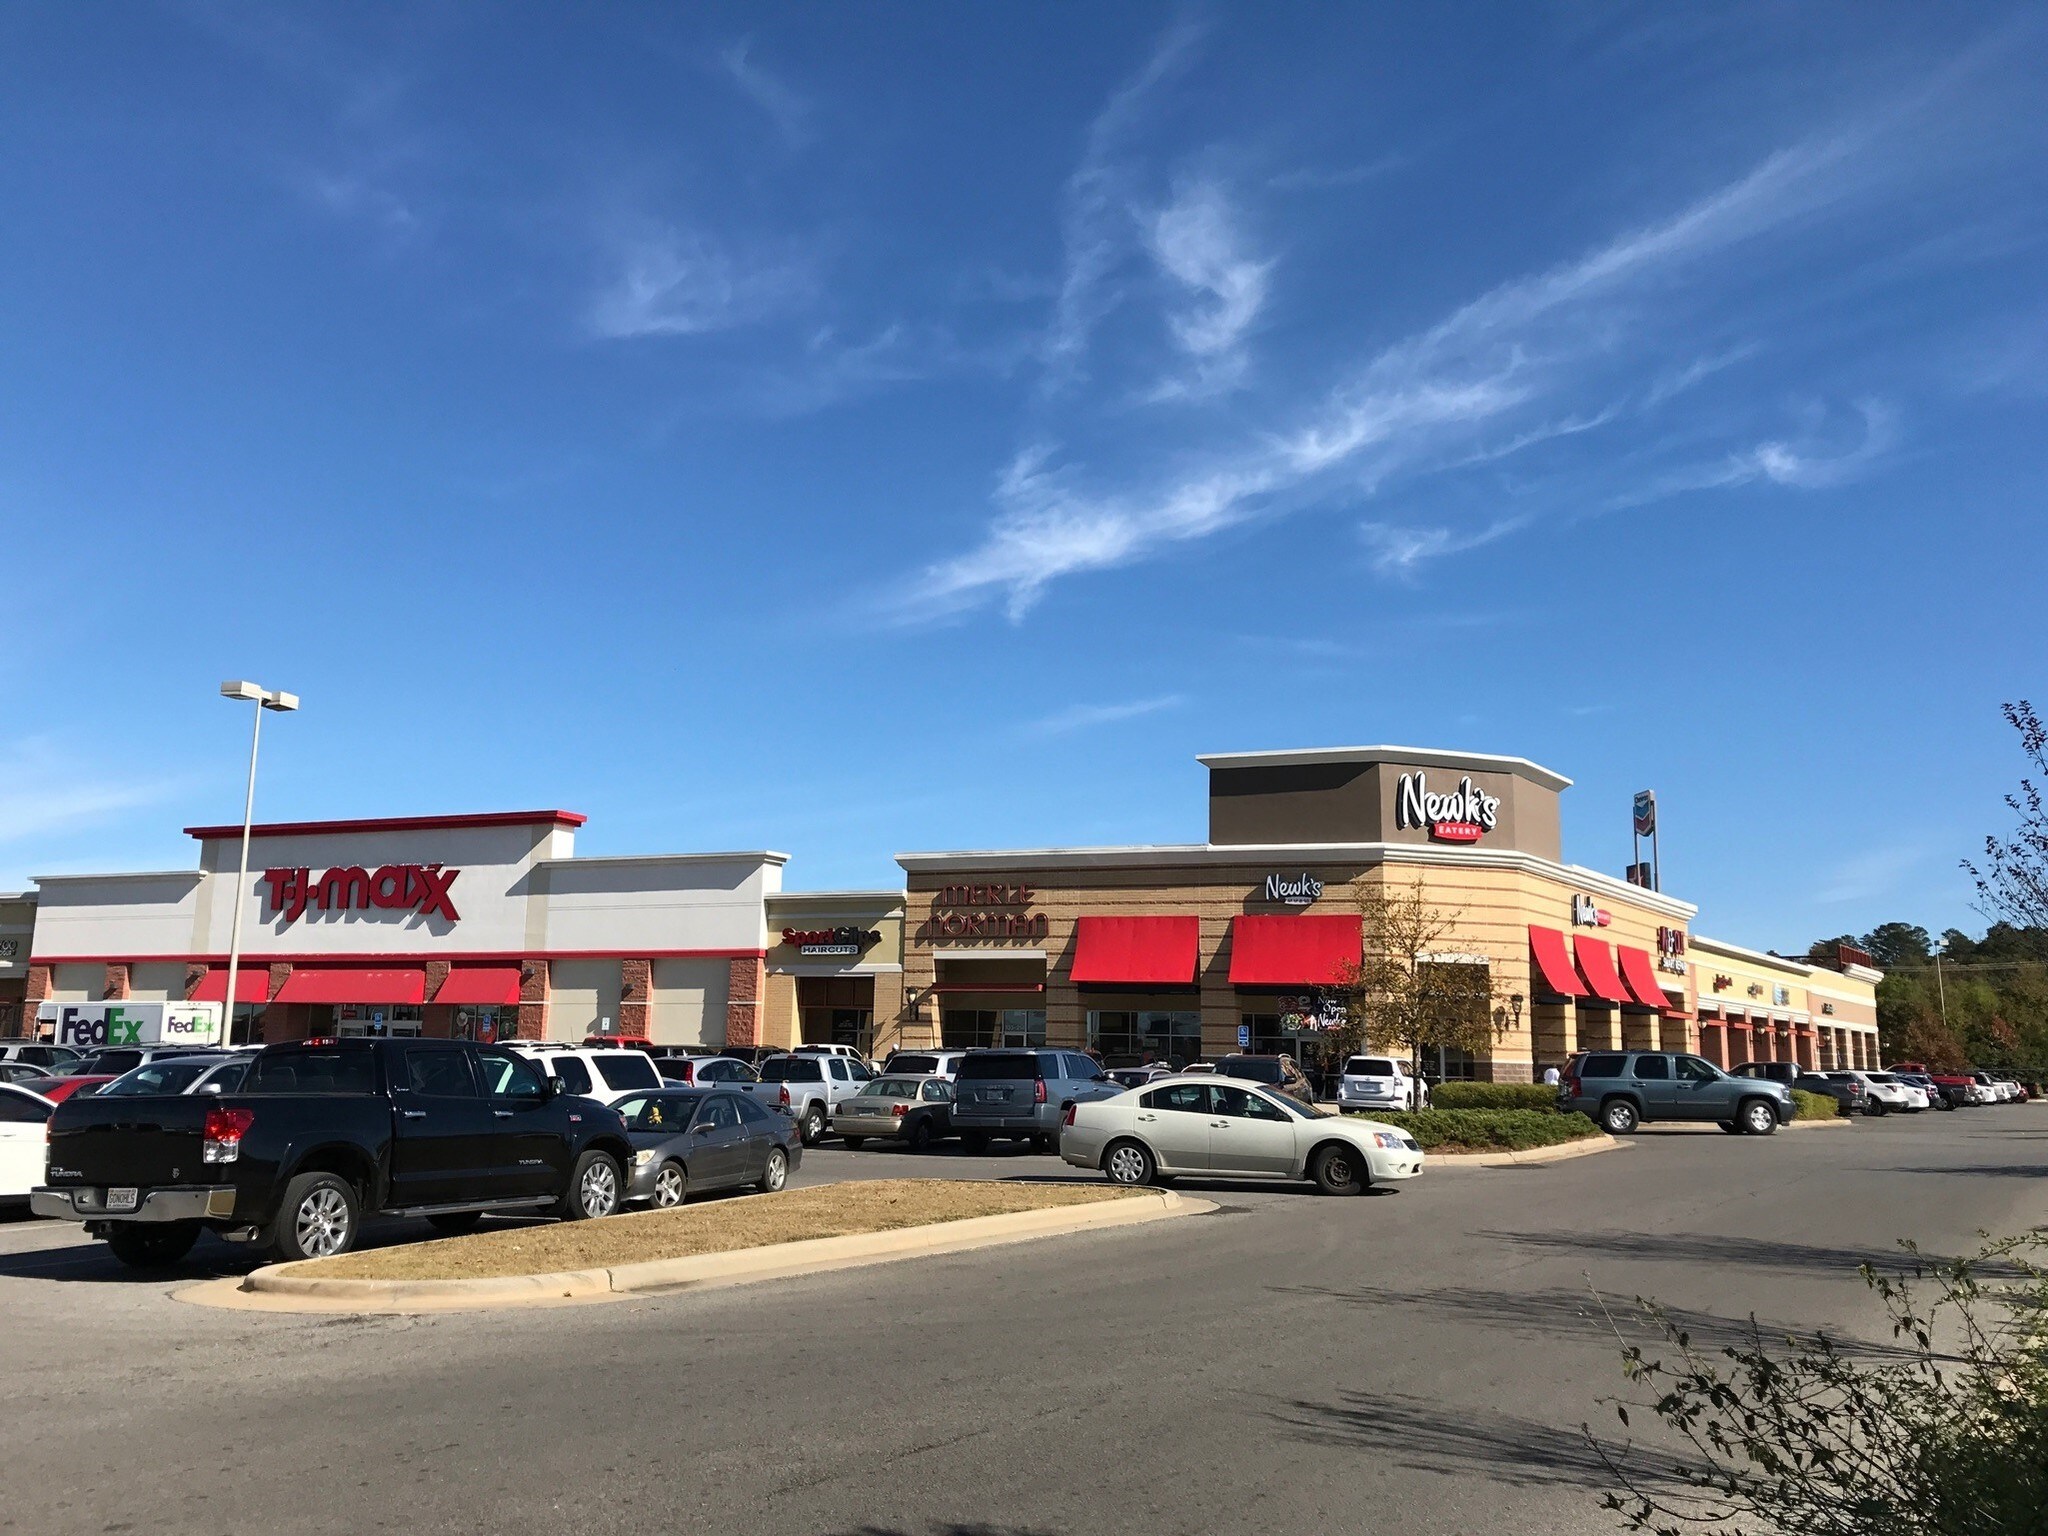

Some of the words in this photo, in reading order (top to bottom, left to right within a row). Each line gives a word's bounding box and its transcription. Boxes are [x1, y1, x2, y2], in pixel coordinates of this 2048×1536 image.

[1398, 771, 1500, 828] Newk's
[1438, 825, 1478, 836] EATERY
[941, 882, 1036, 905] MERLE
[1265, 873, 1322, 900] Newk's
[926, 912, 1049, 937] NORMAN
[803, 946, 857, 954] HAIRCUTS
[61, 1008, 144, 1045] FedEx
[168, 1016, 214, 1033] FedEx
